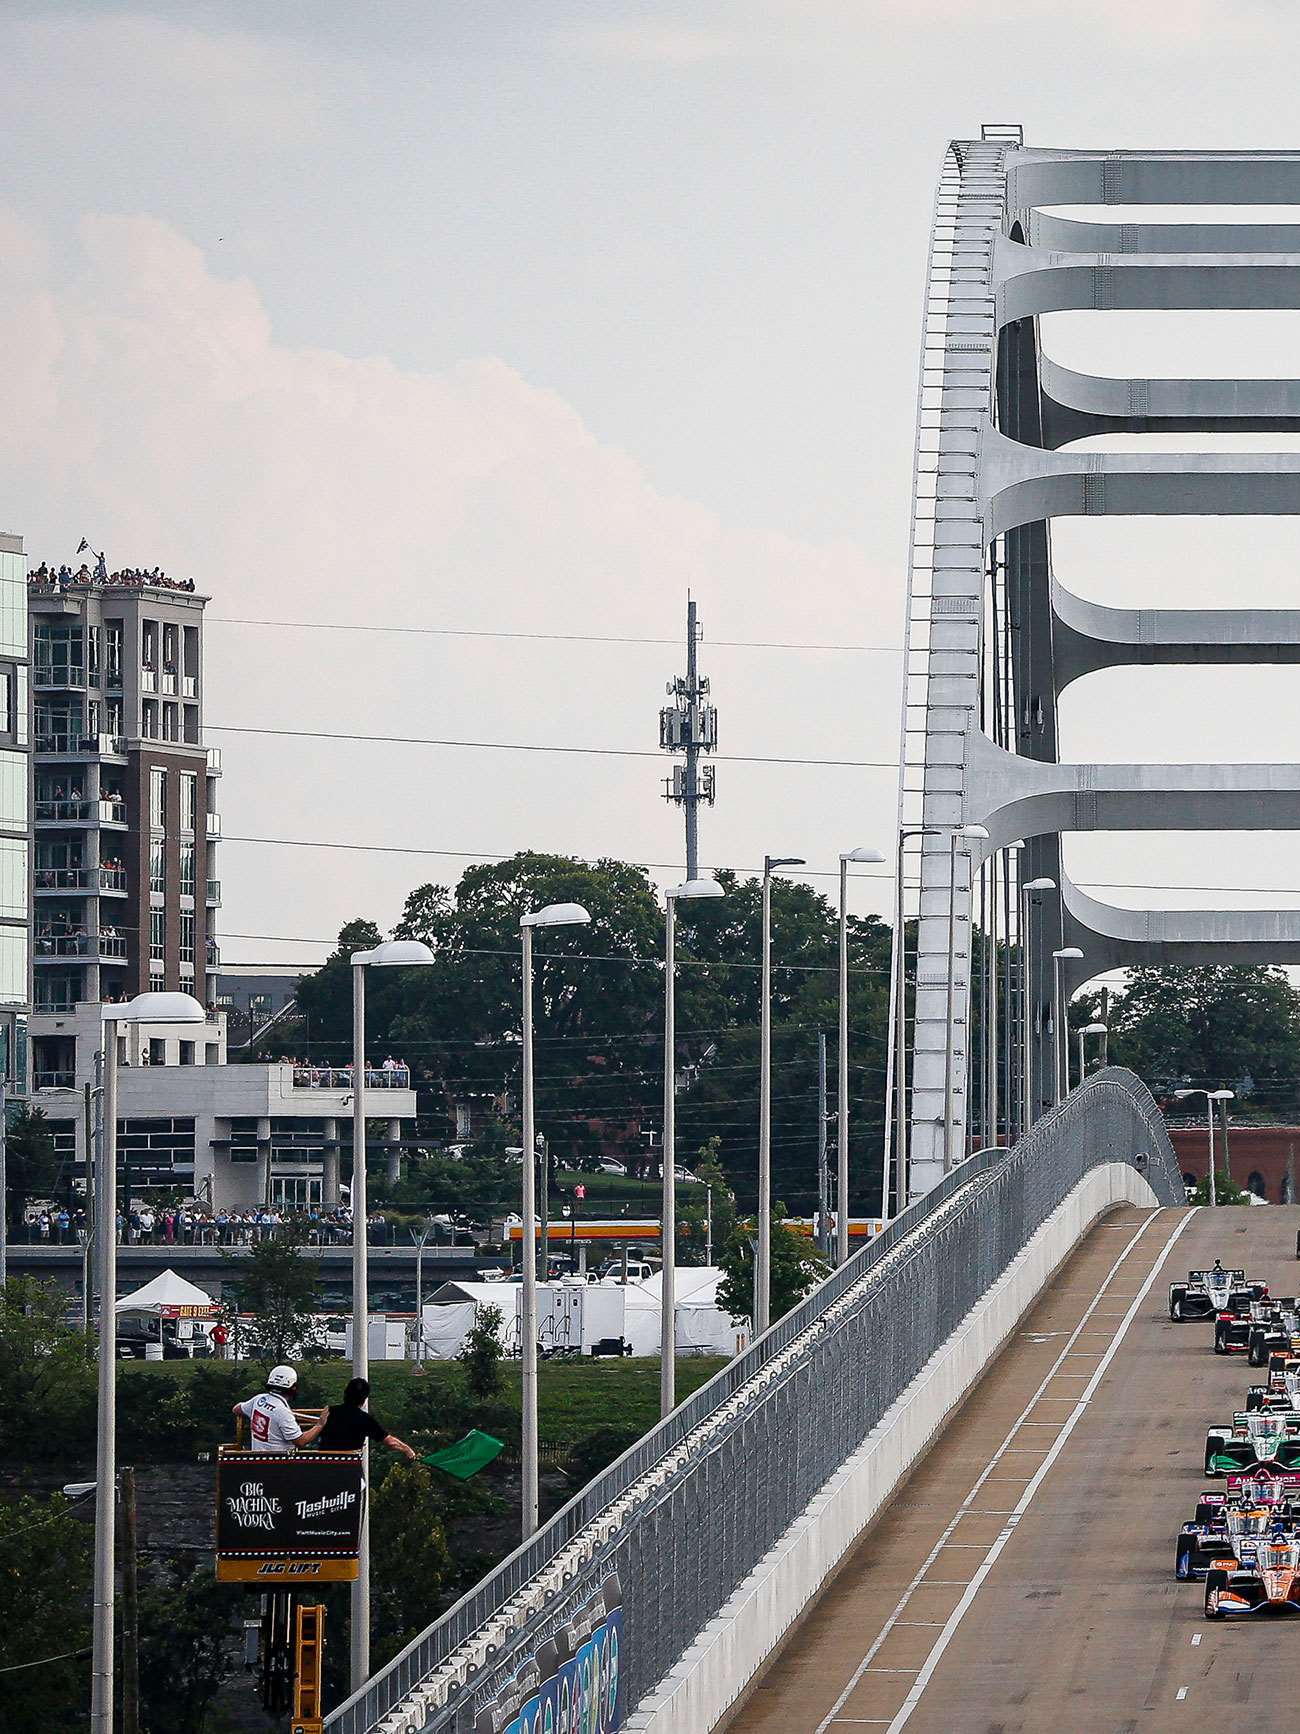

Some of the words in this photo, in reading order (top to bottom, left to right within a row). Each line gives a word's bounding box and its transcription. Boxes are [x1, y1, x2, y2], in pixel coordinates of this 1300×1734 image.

[180, 1306, 193, 1317] GATE
[240, 1482, 264, 1497] BIG
[226, 1497, 283, 1514] MACHINE
[295, 1491, 356, 1519] Nashville
[232, 1512, 276, 1531] VODKA
[257, 1562, 286, 1575] JLG
[287, 1562, 322, 1575] LIFT
